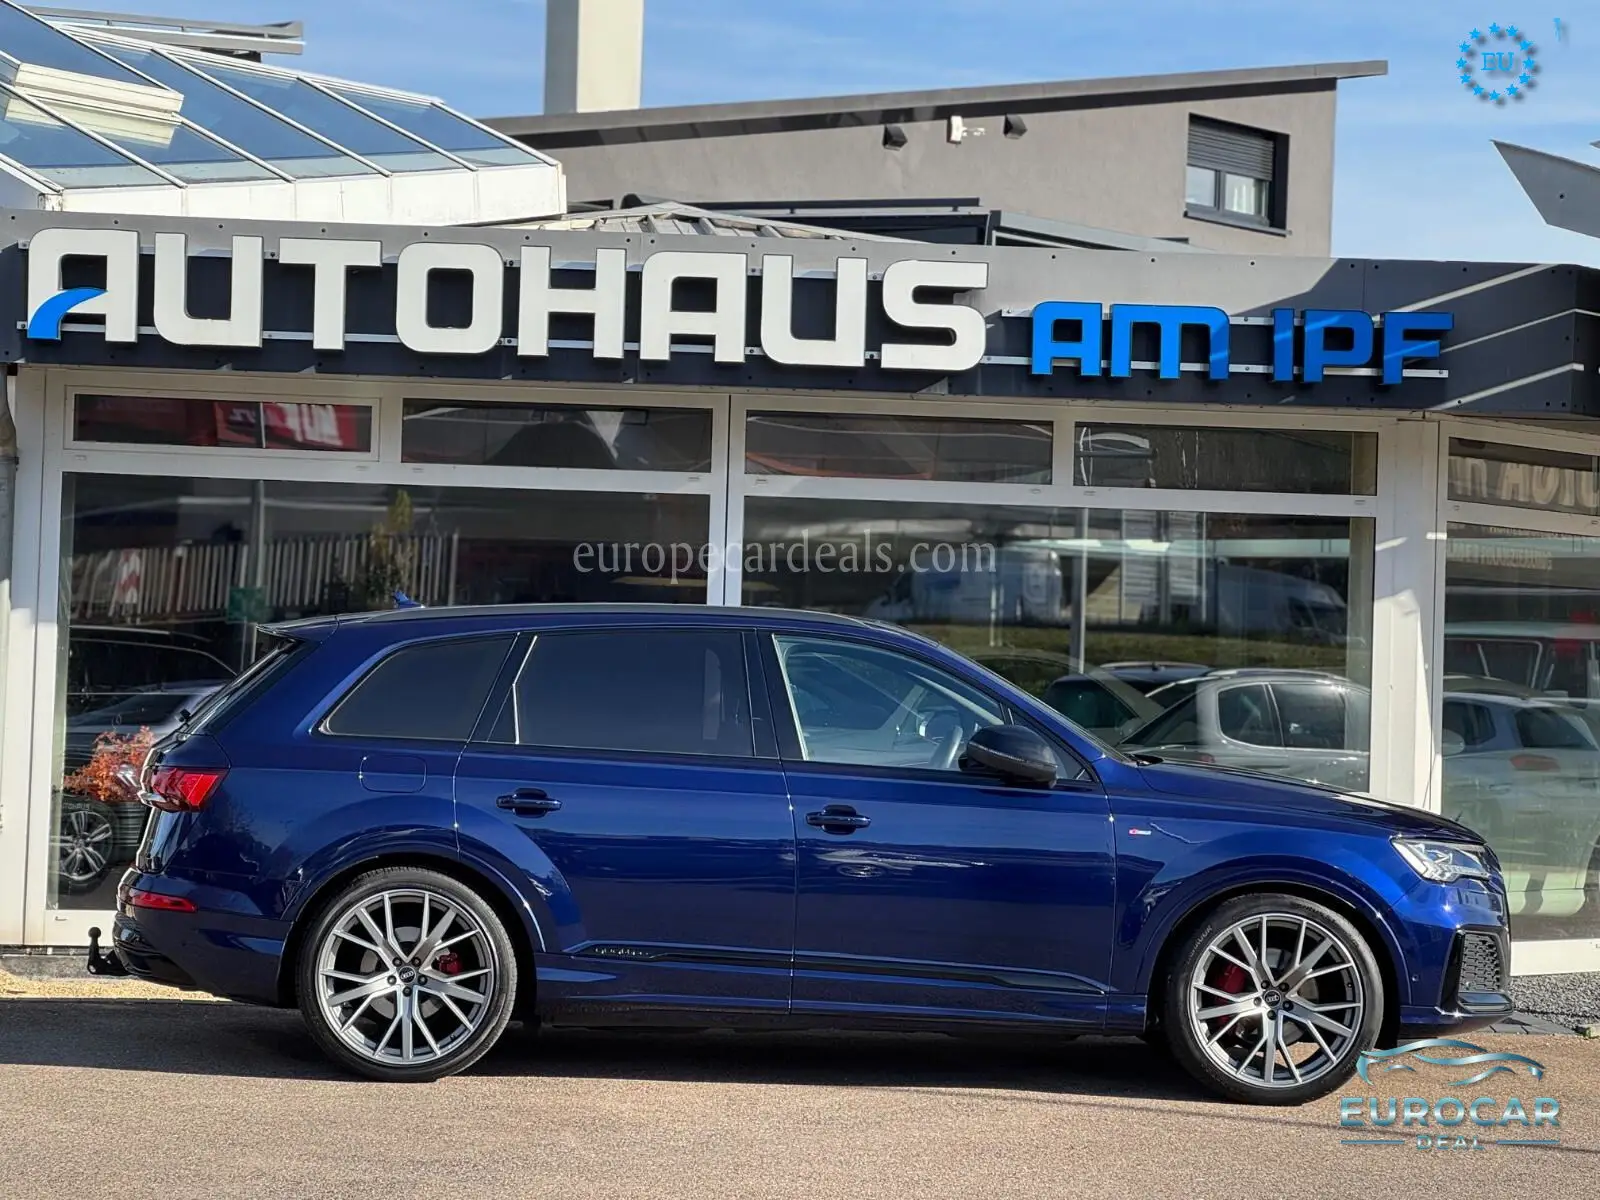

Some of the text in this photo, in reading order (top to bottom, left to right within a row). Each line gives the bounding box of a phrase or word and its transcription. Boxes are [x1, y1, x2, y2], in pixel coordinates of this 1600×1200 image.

[27, 228, 1454, 385] AUTOHAUS AM IPF
